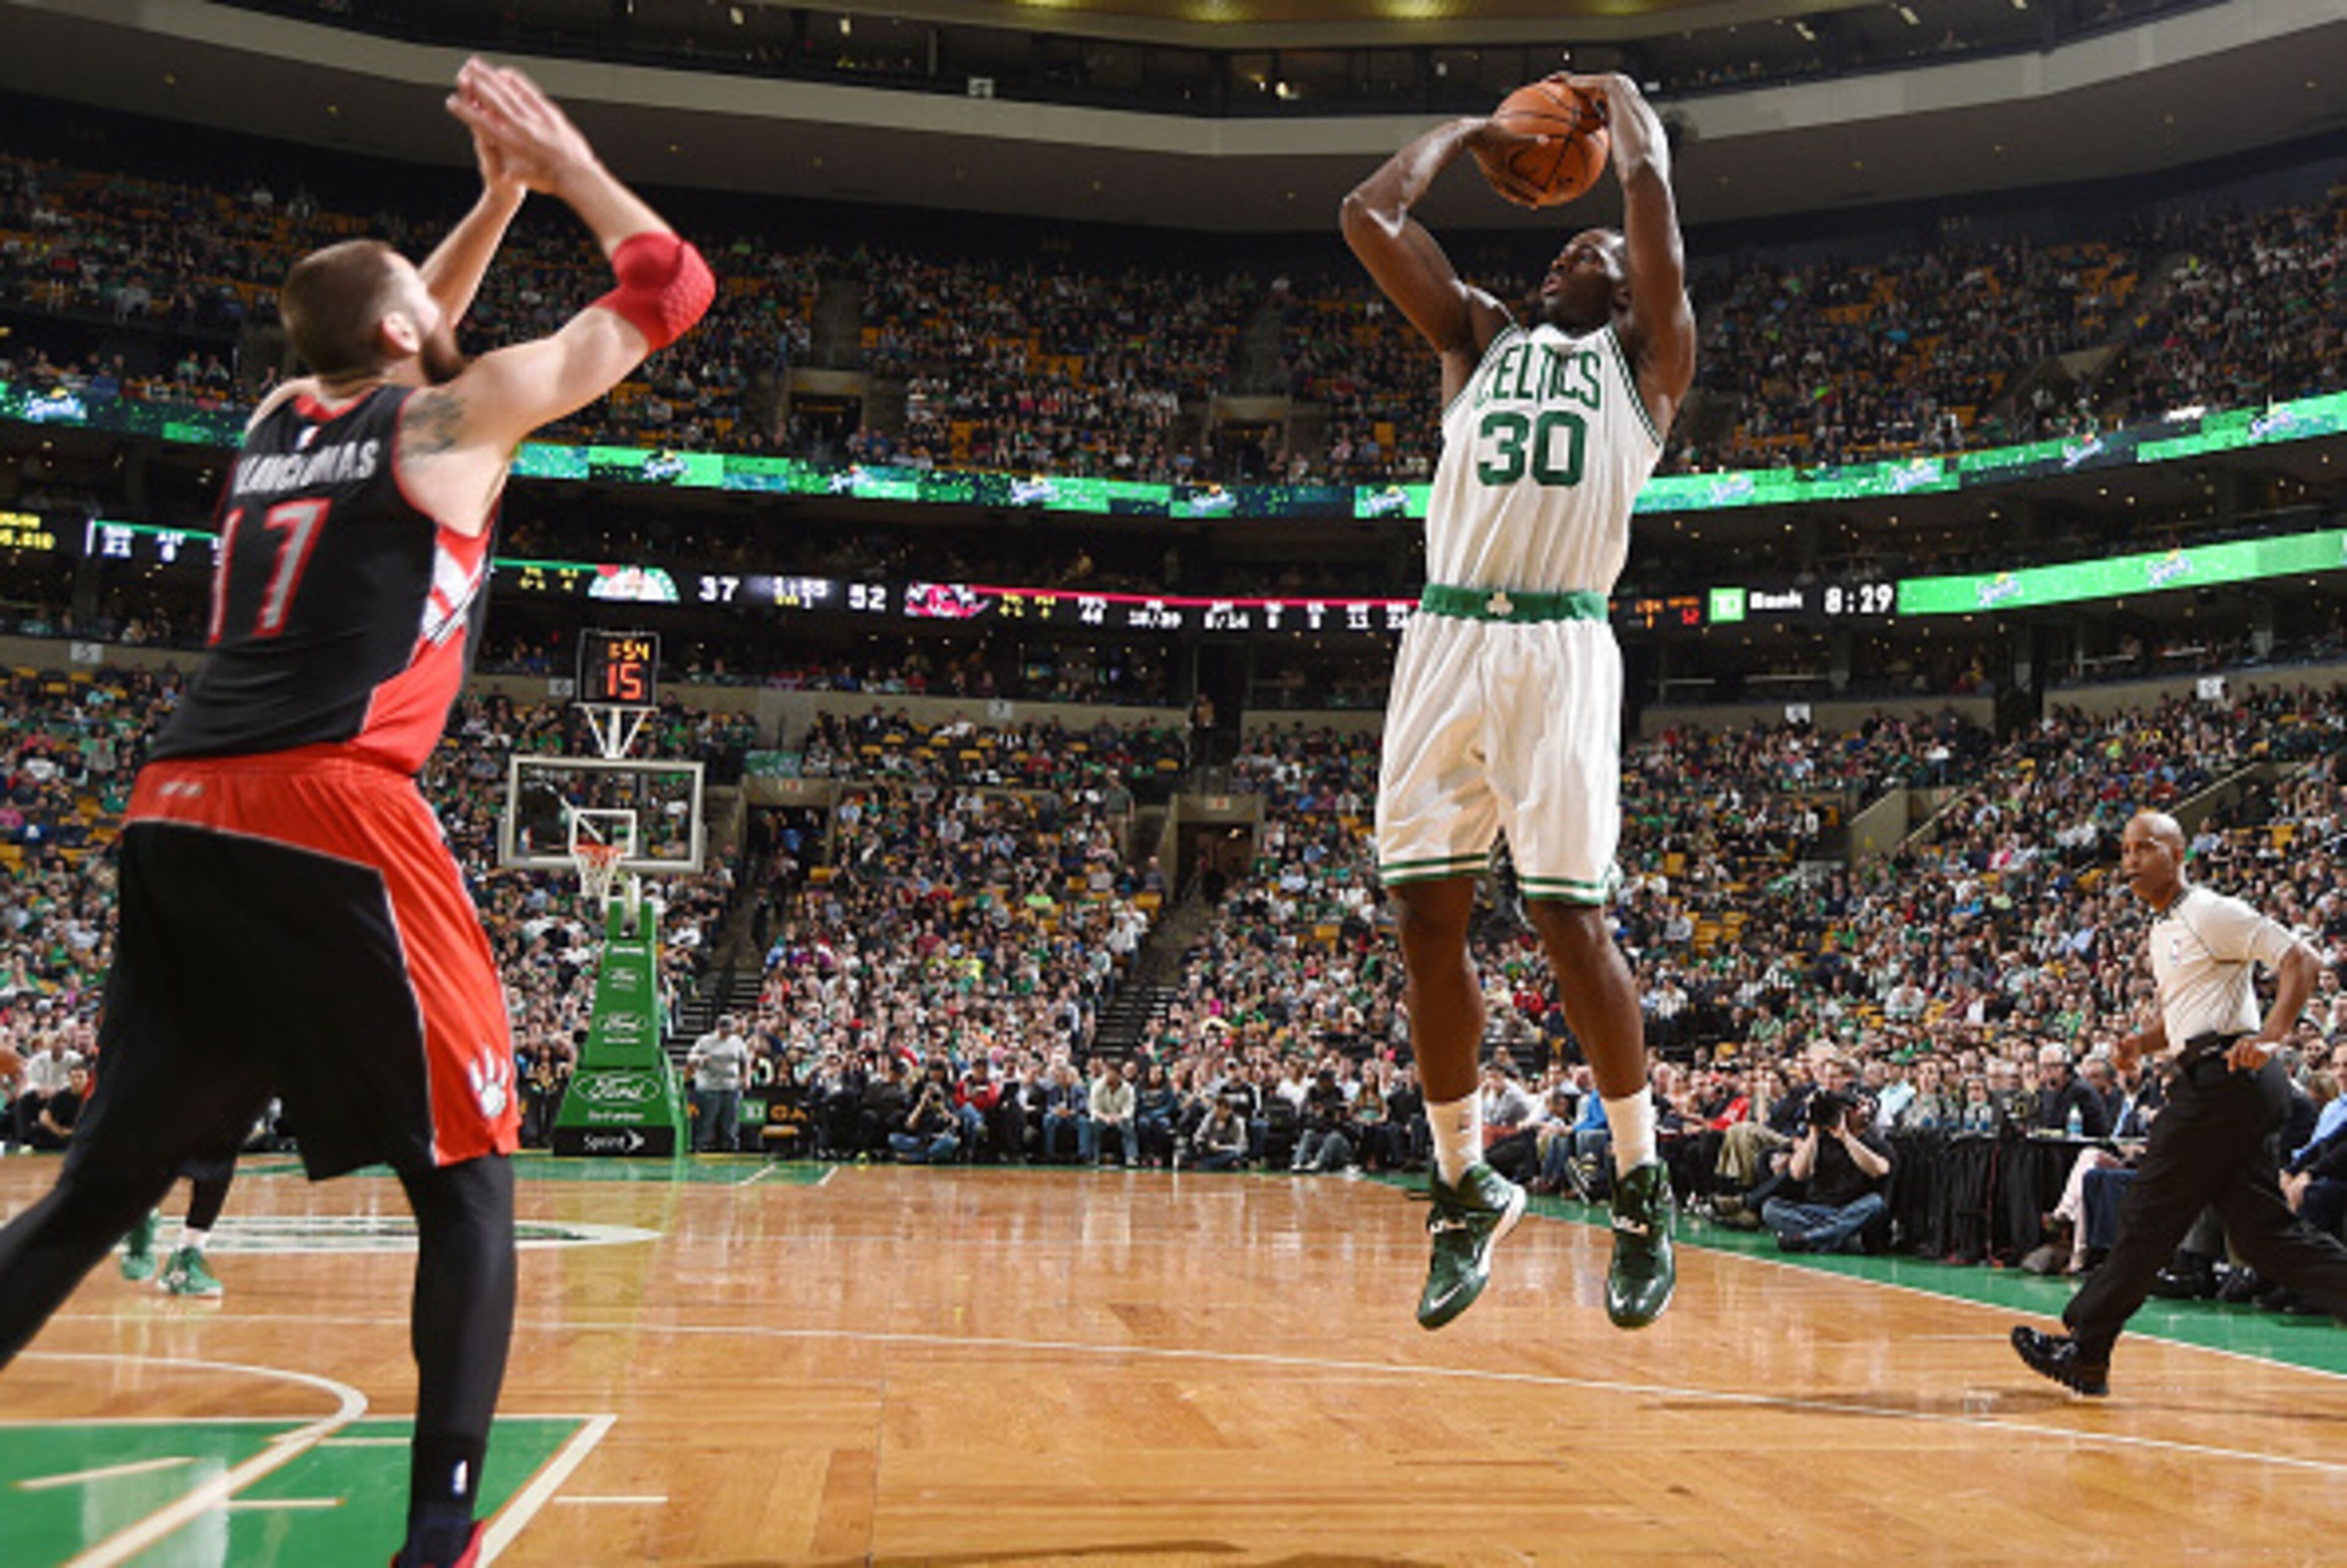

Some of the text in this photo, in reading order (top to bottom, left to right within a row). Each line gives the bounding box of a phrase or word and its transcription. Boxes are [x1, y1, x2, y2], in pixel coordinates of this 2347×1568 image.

[1474, 343, 1601, 411] CELTICS
[1477, 411, 1587, 488] 30
[207, 497, 332, 647] 17
[699, 576, 740, 601] 37
[848, 583, 886, 610] 52
[1713, 595, 1738, 615] TD
[1749, 590, 1803, 610] Bank
[1824, 584, 1893, 614] 8:29
[607, 662, 642, 700] 15
[587, 1074, 645, 1100] Ford
